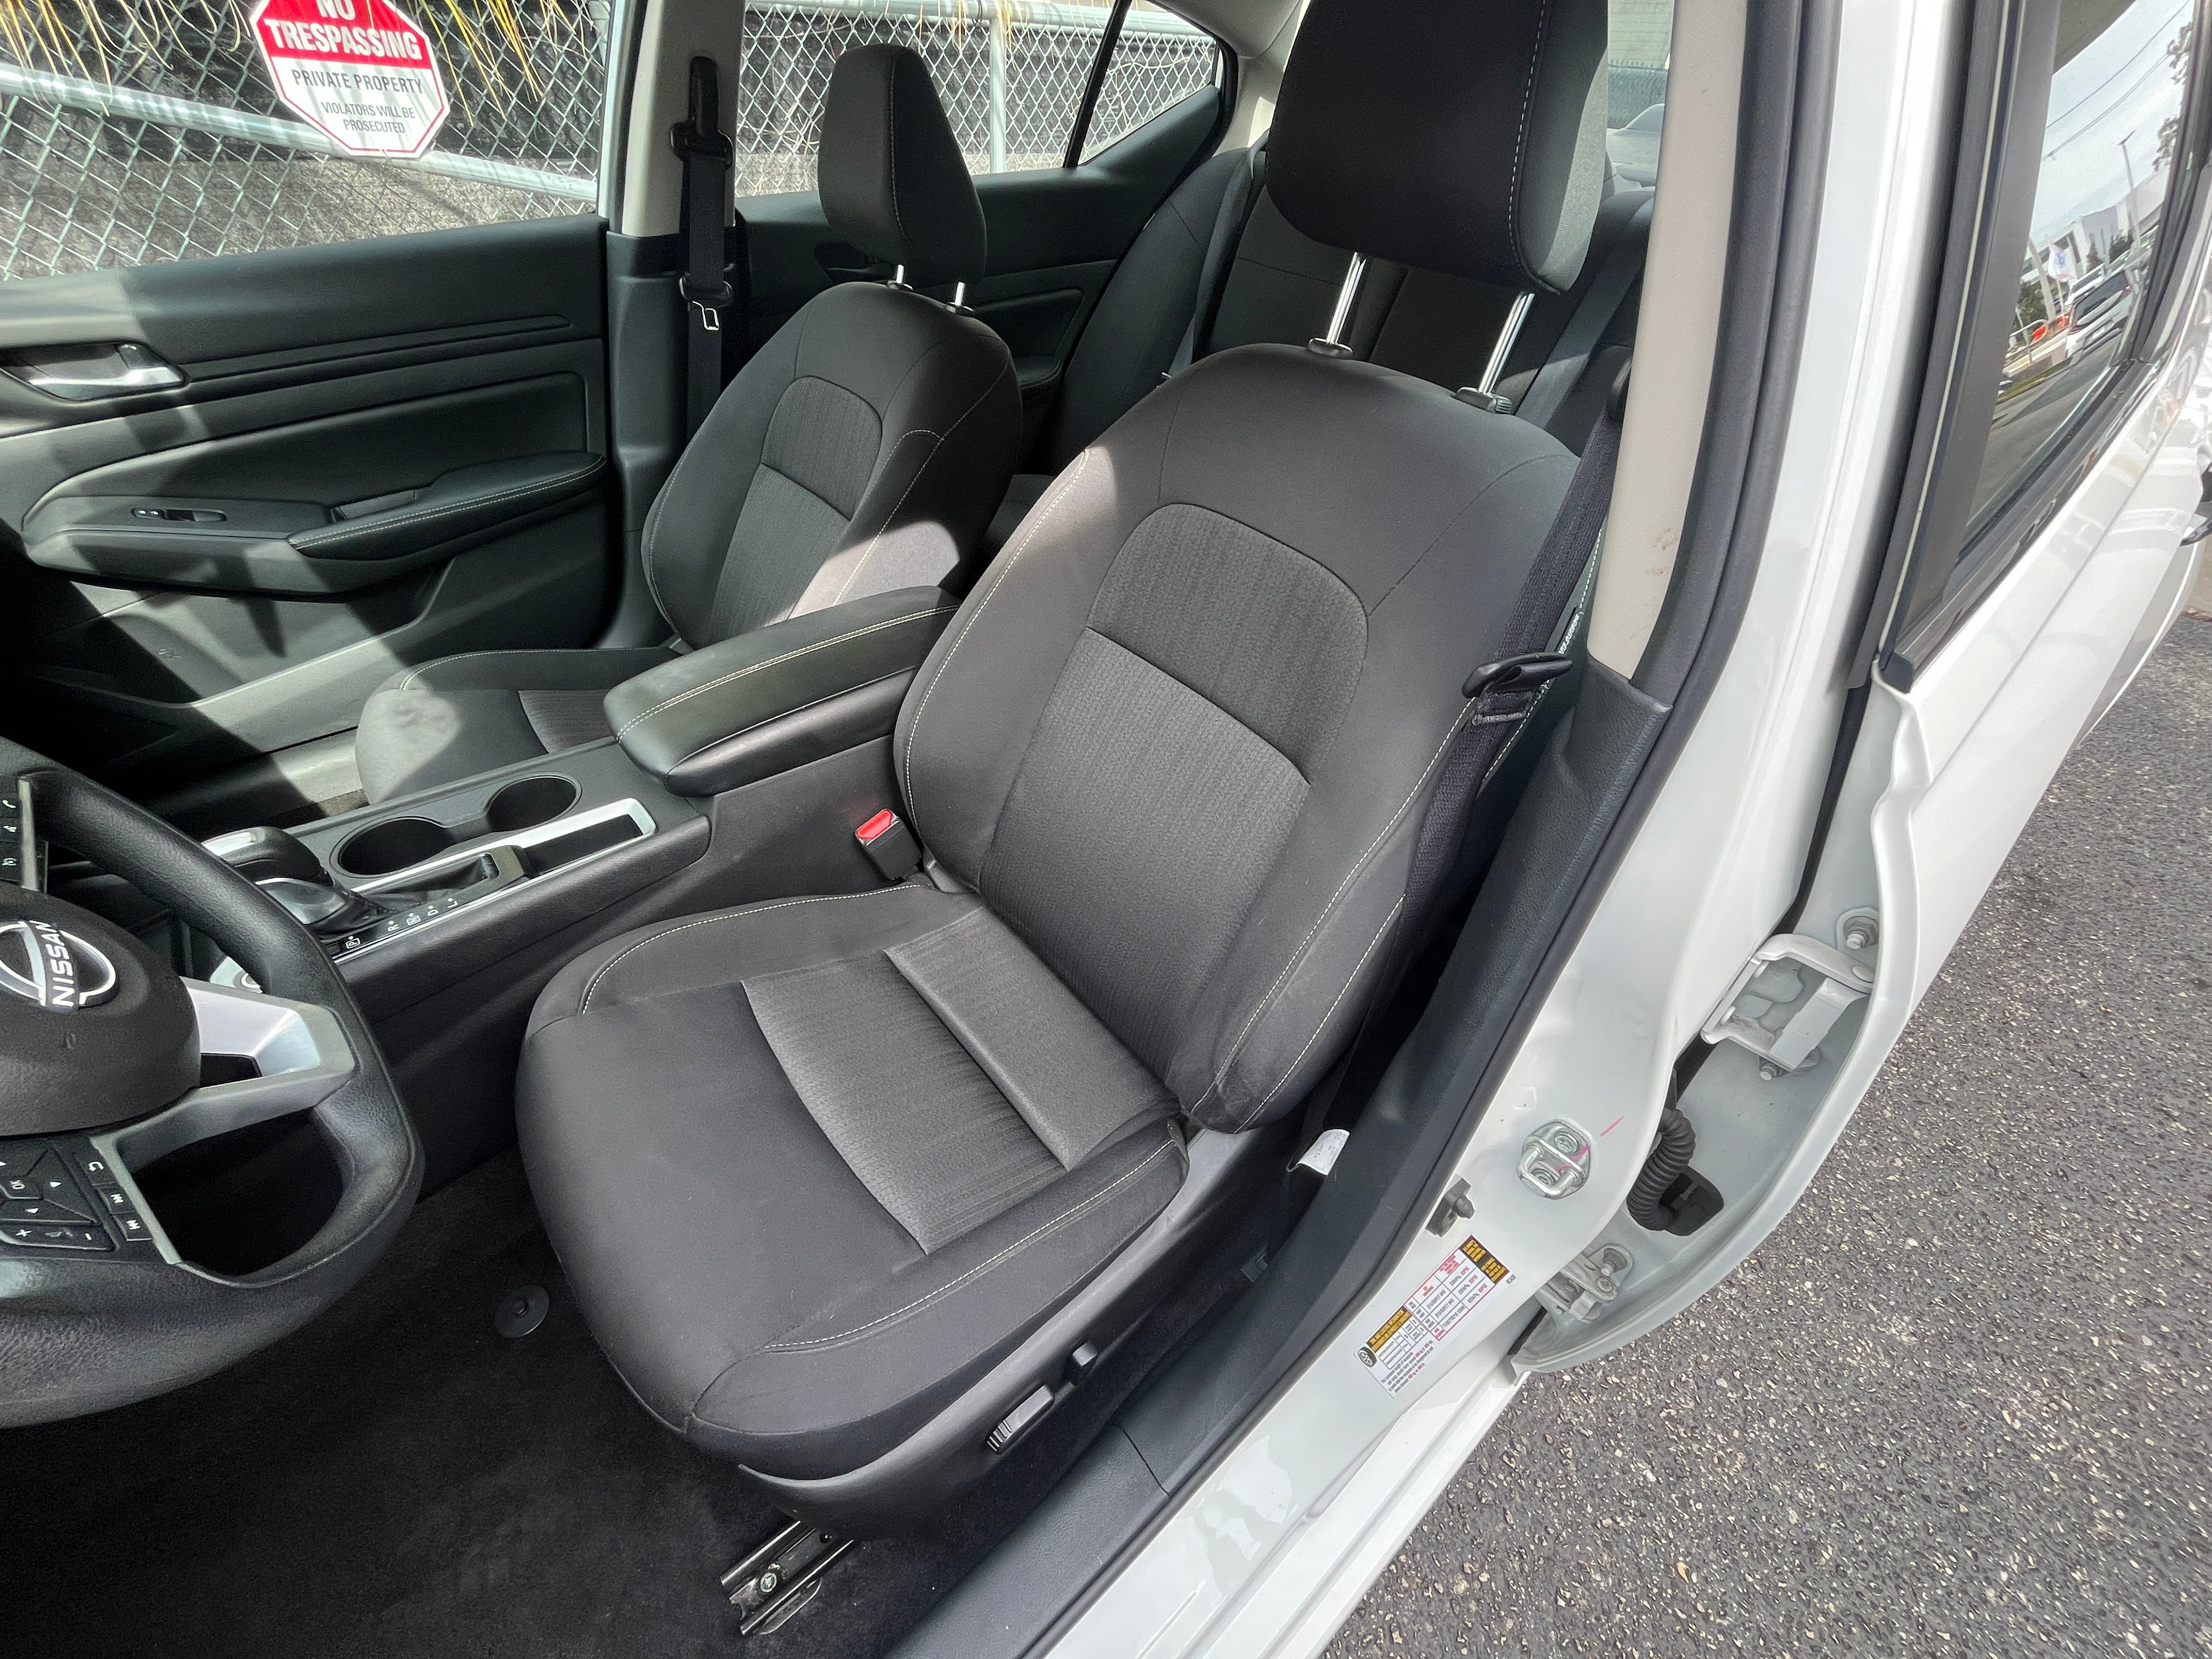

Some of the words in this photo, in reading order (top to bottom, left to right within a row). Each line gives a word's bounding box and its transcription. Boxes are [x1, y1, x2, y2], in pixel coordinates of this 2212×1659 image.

[318, 0, 356, 20] NO
[263, 18, 422, 60] TRESPASSING
[291, 69, 352, 89] PRIVATE
[353, 75, 424, 94] PROPERTY
[320, 101, 376, 116] VIOLATORS
[376, 105, 402, 118] WILL
[403, 107, 416, 119] BE
[343, 119, 405, 133] PROSECUTED
[387, 924, 399, 932] R
[447, 900, 458, 909] L
[29, 920, 75, 1007] NISSAN
[10, 1180, 25, 1190] OK
